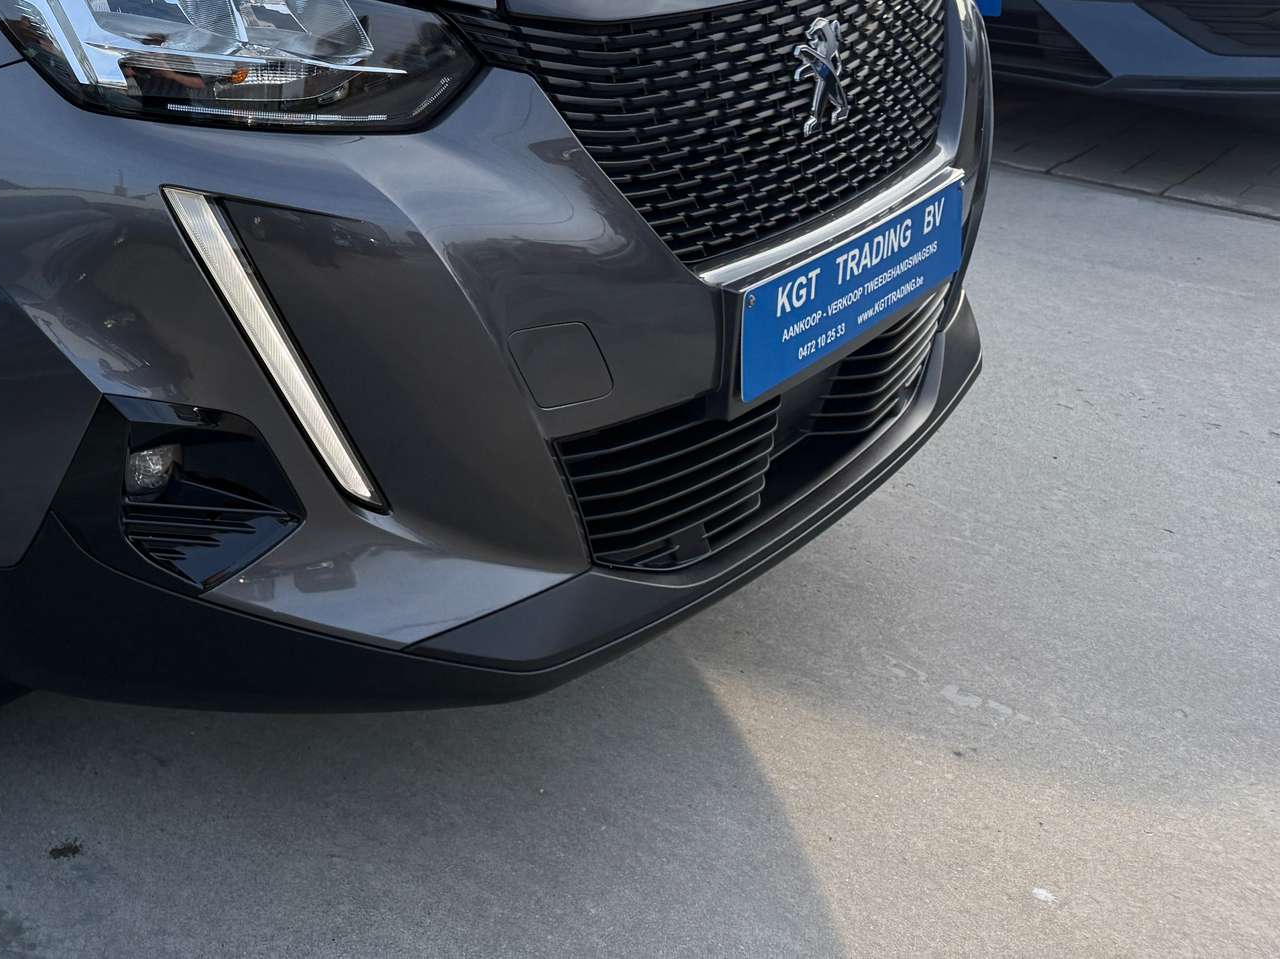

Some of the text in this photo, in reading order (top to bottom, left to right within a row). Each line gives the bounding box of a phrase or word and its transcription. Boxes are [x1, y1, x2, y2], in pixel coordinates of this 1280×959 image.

[776, 197, 945, 318] KGT TRADING BV
[782, 310, 823, 342] AANKOOP
[827, 286, 863, 318] VERKOOP
[864, 241, 938, 296] TWEEDEHANDSWAGENS
[798, 276, 924, 360] 0472 10 25 33 www.KGTTRADING.be
